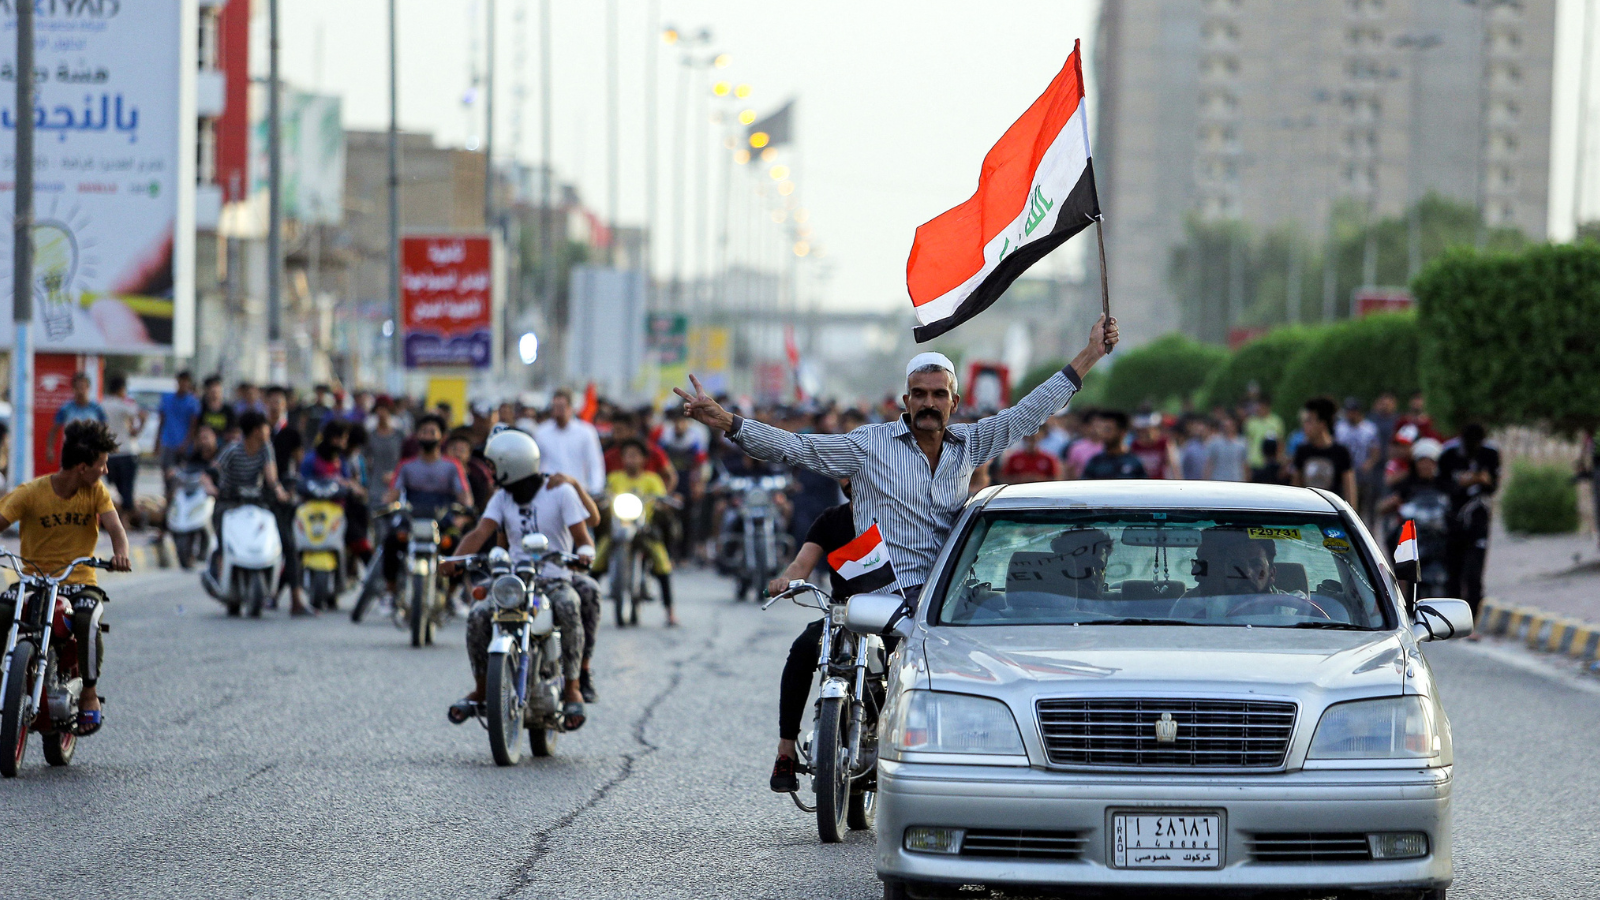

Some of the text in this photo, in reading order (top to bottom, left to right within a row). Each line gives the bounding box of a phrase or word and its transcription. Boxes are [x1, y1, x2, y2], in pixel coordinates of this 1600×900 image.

[1250, 529, 1298, 537] F29731
[1135, 853, 1211, 863] كركوك خصوصي
